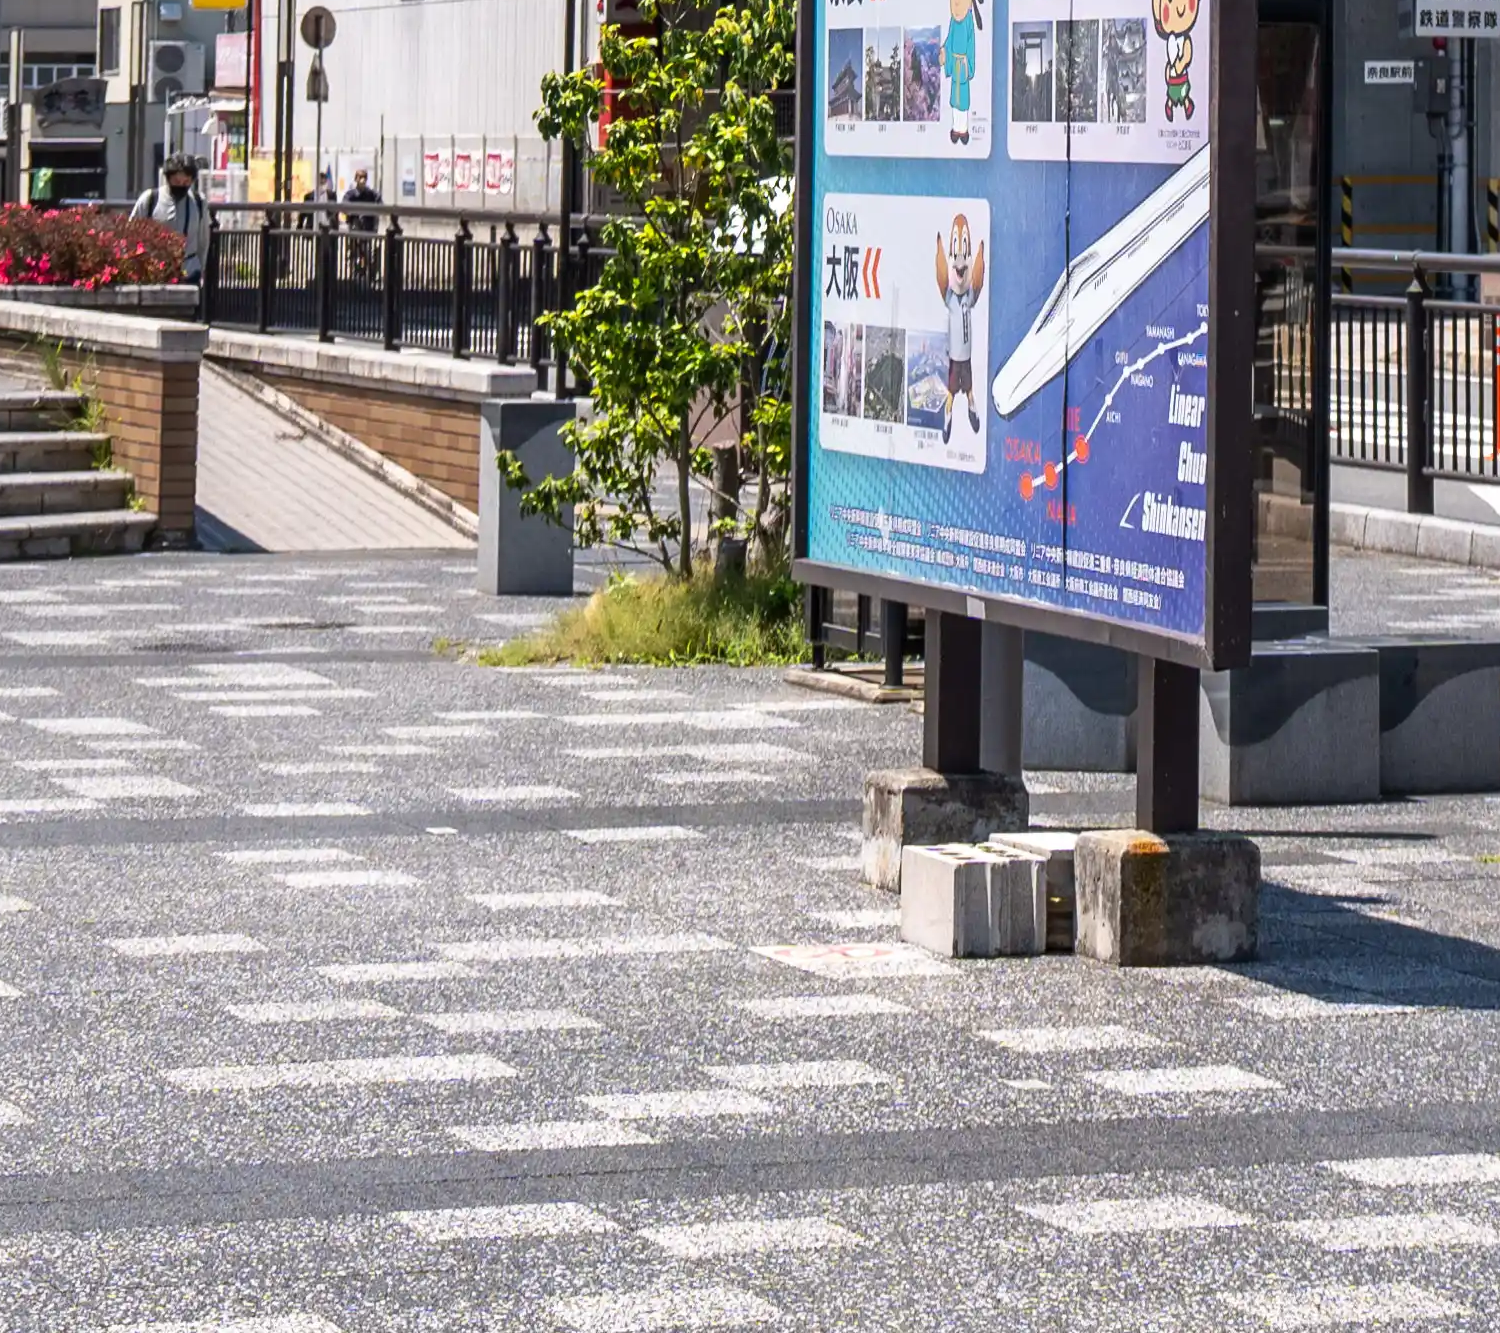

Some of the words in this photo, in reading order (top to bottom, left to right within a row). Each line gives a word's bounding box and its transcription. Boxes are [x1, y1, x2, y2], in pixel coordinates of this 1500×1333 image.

[1419, 9, 1499, 30] 鉄道警察隊
[1367, 66, 1413, 80] 奈良駅前
[826, 206, 858, 235] OSAKA
[825, 244, 860, 301] 大阪
[1146, 324, 1175, 339] YAMANASHI
[1115, 350, 1129, 365] GIFU
[1130, 375, 1154, 388] NAGANO
[1105, 411, 1121, 424] AICHI
[1168, 384, 1206, 428] Linear
[1005, 436, 1042, 466] OSAKA
[1177, 440, 1208, 486] Chuo
[1141, 490, 1207, 542] Shinkansen
